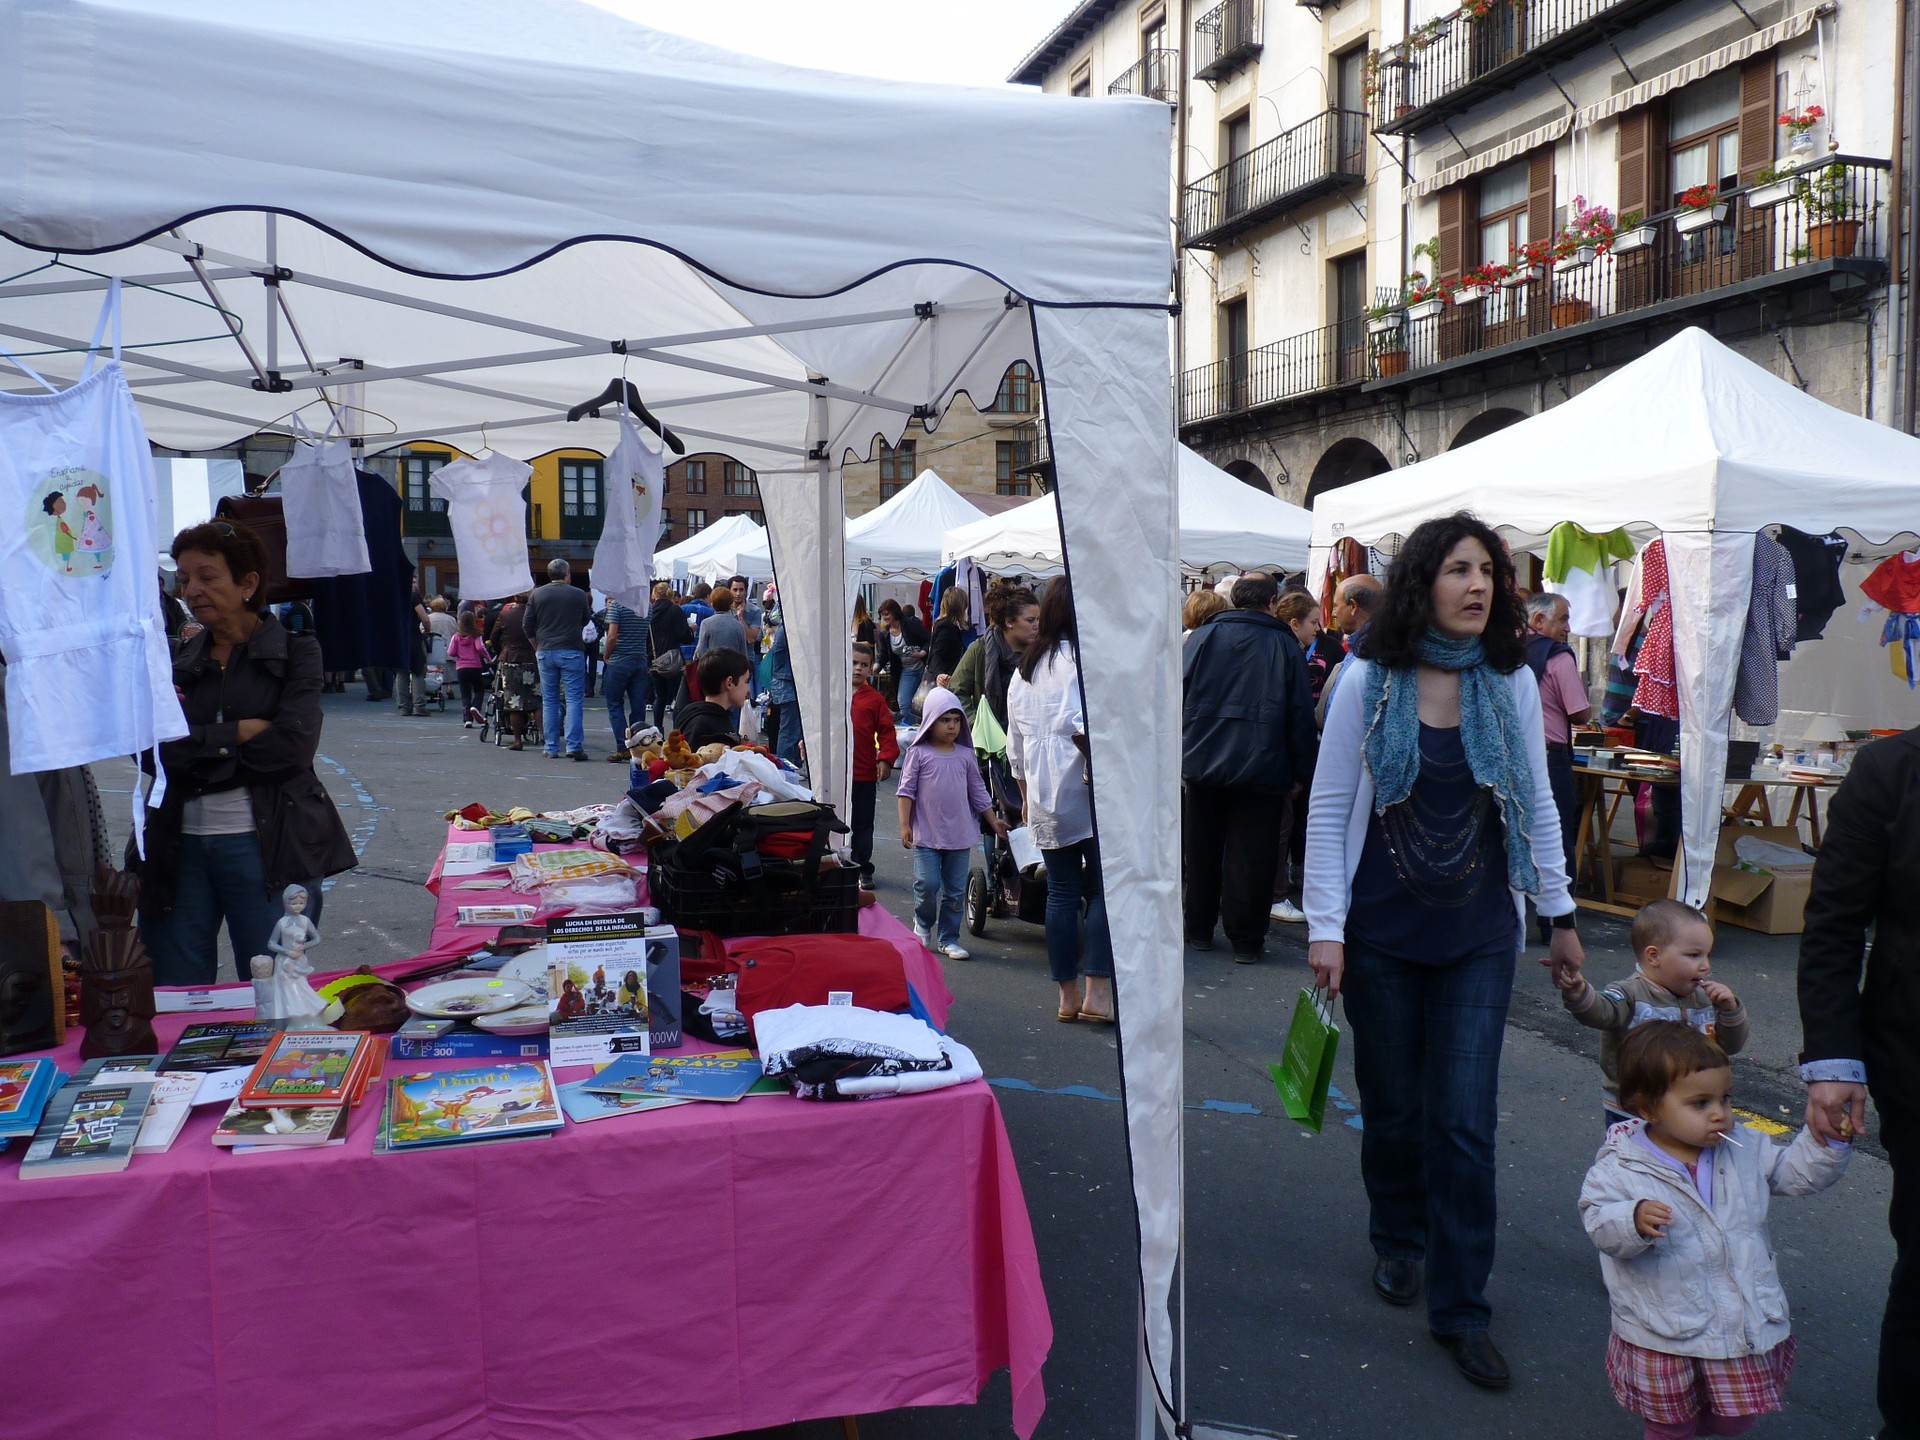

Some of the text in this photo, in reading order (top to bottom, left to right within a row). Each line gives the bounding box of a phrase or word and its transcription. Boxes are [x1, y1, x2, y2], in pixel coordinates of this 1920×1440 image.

[593, 918, 616, 926] DEFENSA
[565, 926, 593, 934] DERECHOS
[208, 1026, 267, 1034] Navarra
[433, 1047, 453, 1056] 300
[651, 1057, 739, 1068] BRAVO
[82, 1090, 126, 1098] Connemara
